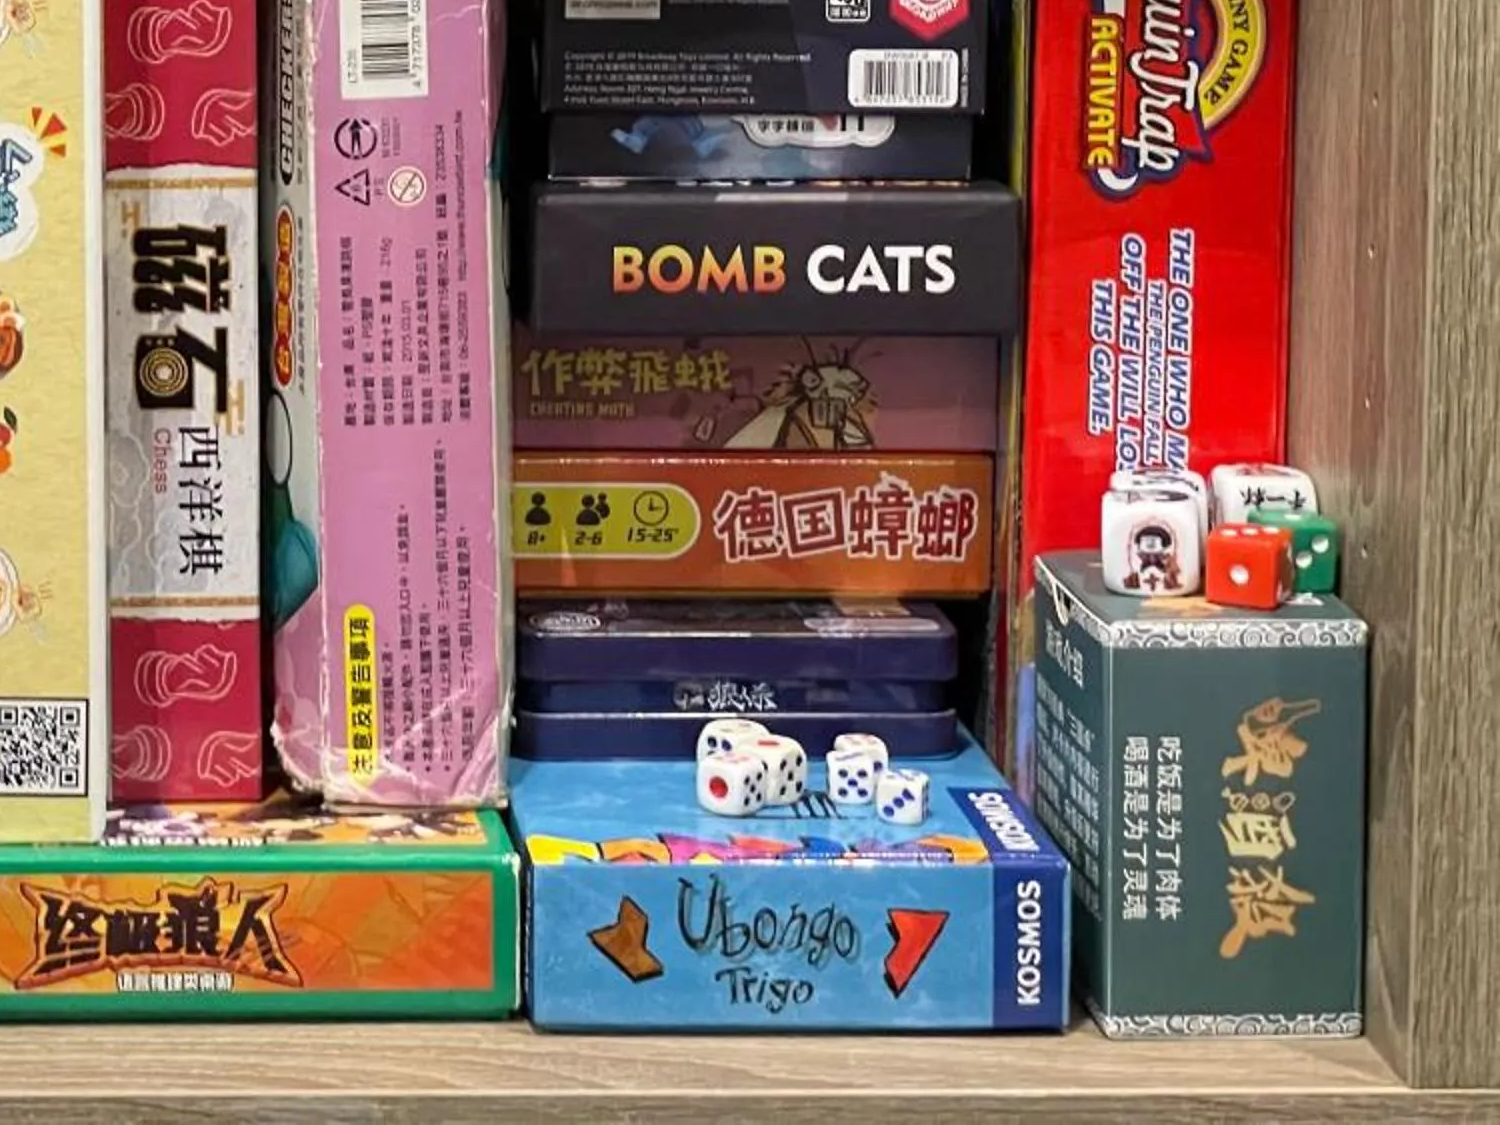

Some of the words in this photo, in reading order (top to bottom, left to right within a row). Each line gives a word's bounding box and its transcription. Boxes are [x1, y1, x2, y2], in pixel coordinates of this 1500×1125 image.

[1086, 17, 1119, 167] ACTIVATE
[1203, 41, 1250, 106] GAME
[612, 245, 787, 294] BOMB
[807, 244, 956, 295] CATS
[1122, 235, 1143, 290] OFF
[1170, 228, 1192, 284] THE
[132, 223, 232, 413] 磁石
[1092, 281, 1115, 339] THIS
[1120, 296, 1142, 352] THE
[1148, 281, 1164, 319] THE
[1169, 293, 1190, 351] ONE
[1088, 346, 1114, 432] GAME.
[1118, 356, 1141, 417] WILL
[1145, 324, 1164, 411] PENGUIN
[1166, 356, 1190, 428] WHO
[598, 402, 635, 418] MOTH
[1144, 414, 1162, 463] FALL
[153, 427, 170, 494] Chess
[178, 426, 224, 576] 西洋棋
[713, 472, 979, 562] 德国蟑螂
[575, 531, 603, 546] 2-6
[1123, 736, 1149, 921] 喝酒是为了灵魂
[1155, 736, 1182, 921] 吃饭是为了肉体
[677, 872, 862, 967] Ubongo
[1016, 878, 1042, 1006] KOSMOS
[714, 967, 814, 1014] Trigo
